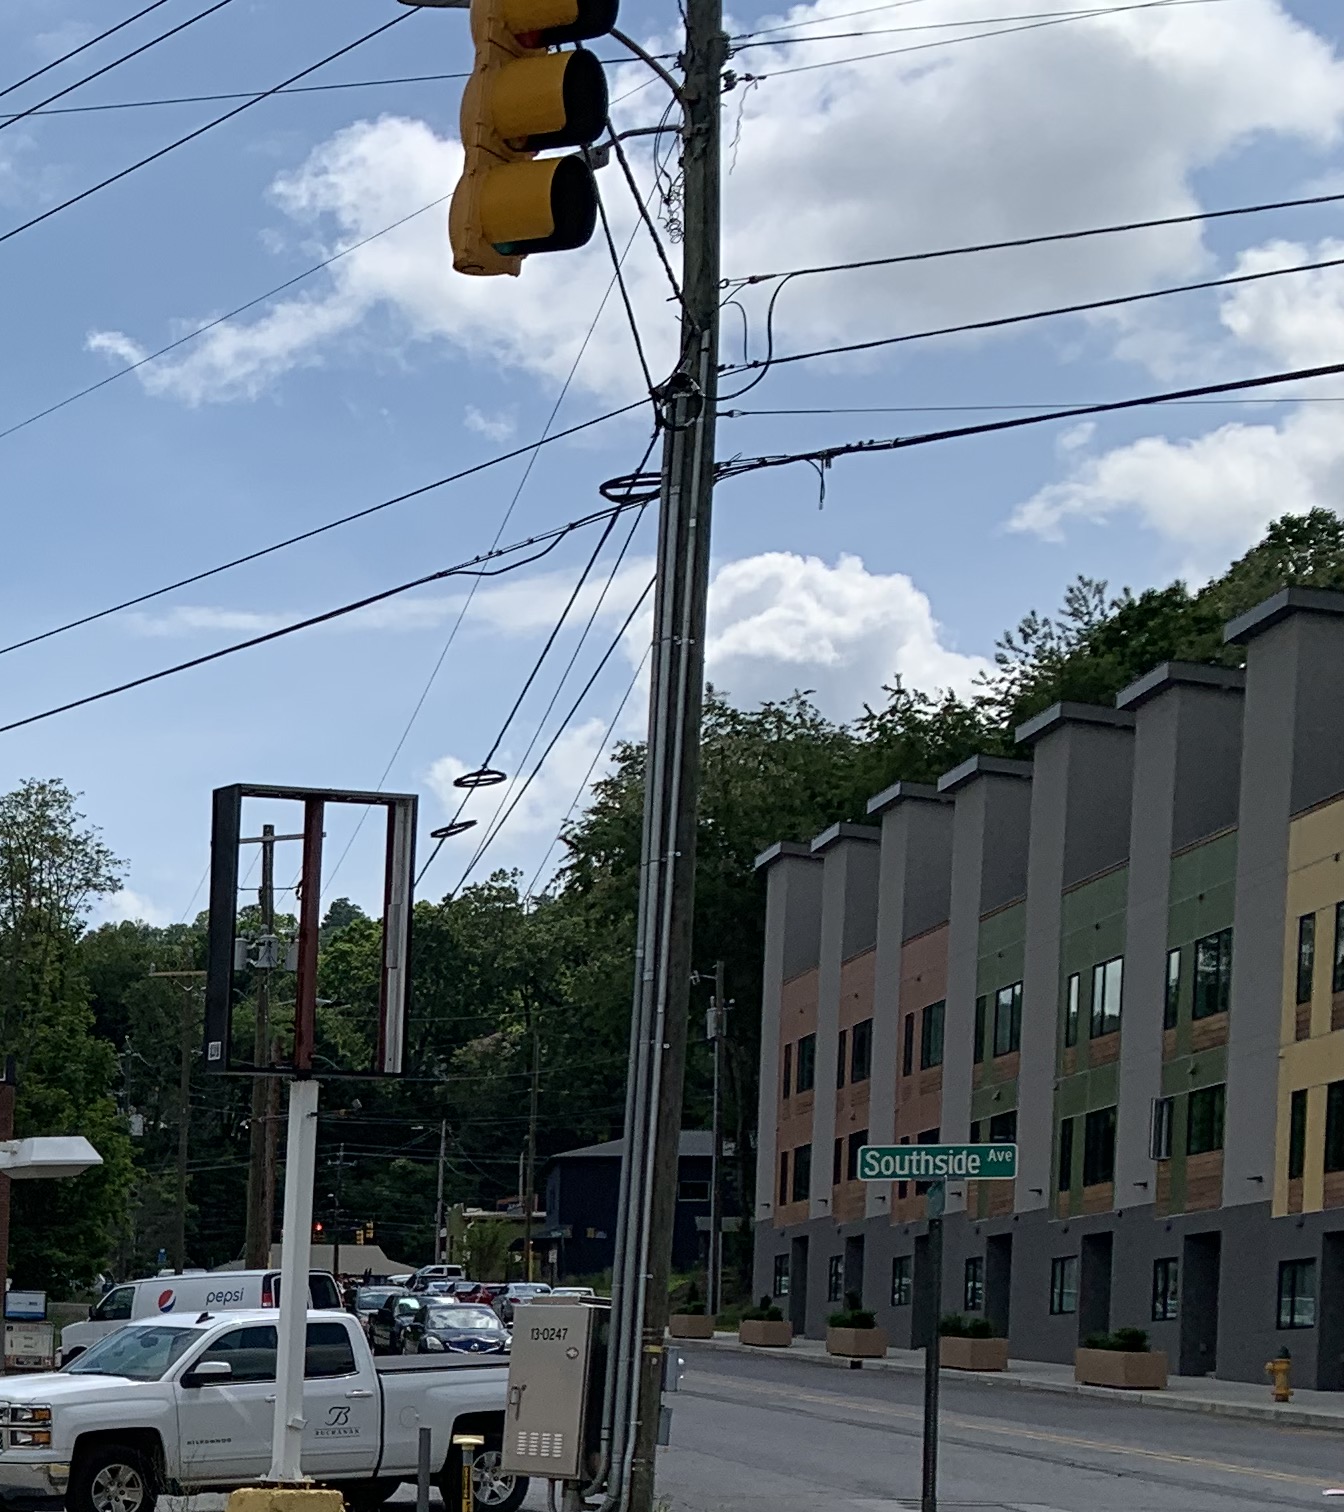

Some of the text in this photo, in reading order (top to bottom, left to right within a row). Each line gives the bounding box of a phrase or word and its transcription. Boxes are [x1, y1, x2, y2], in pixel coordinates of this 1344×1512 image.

[864, 1149, 1012, 1176] Southside Ave
[206, 1287, 244, 1306] pepsi
[530, 1327, 569, 1341] 13-0247
